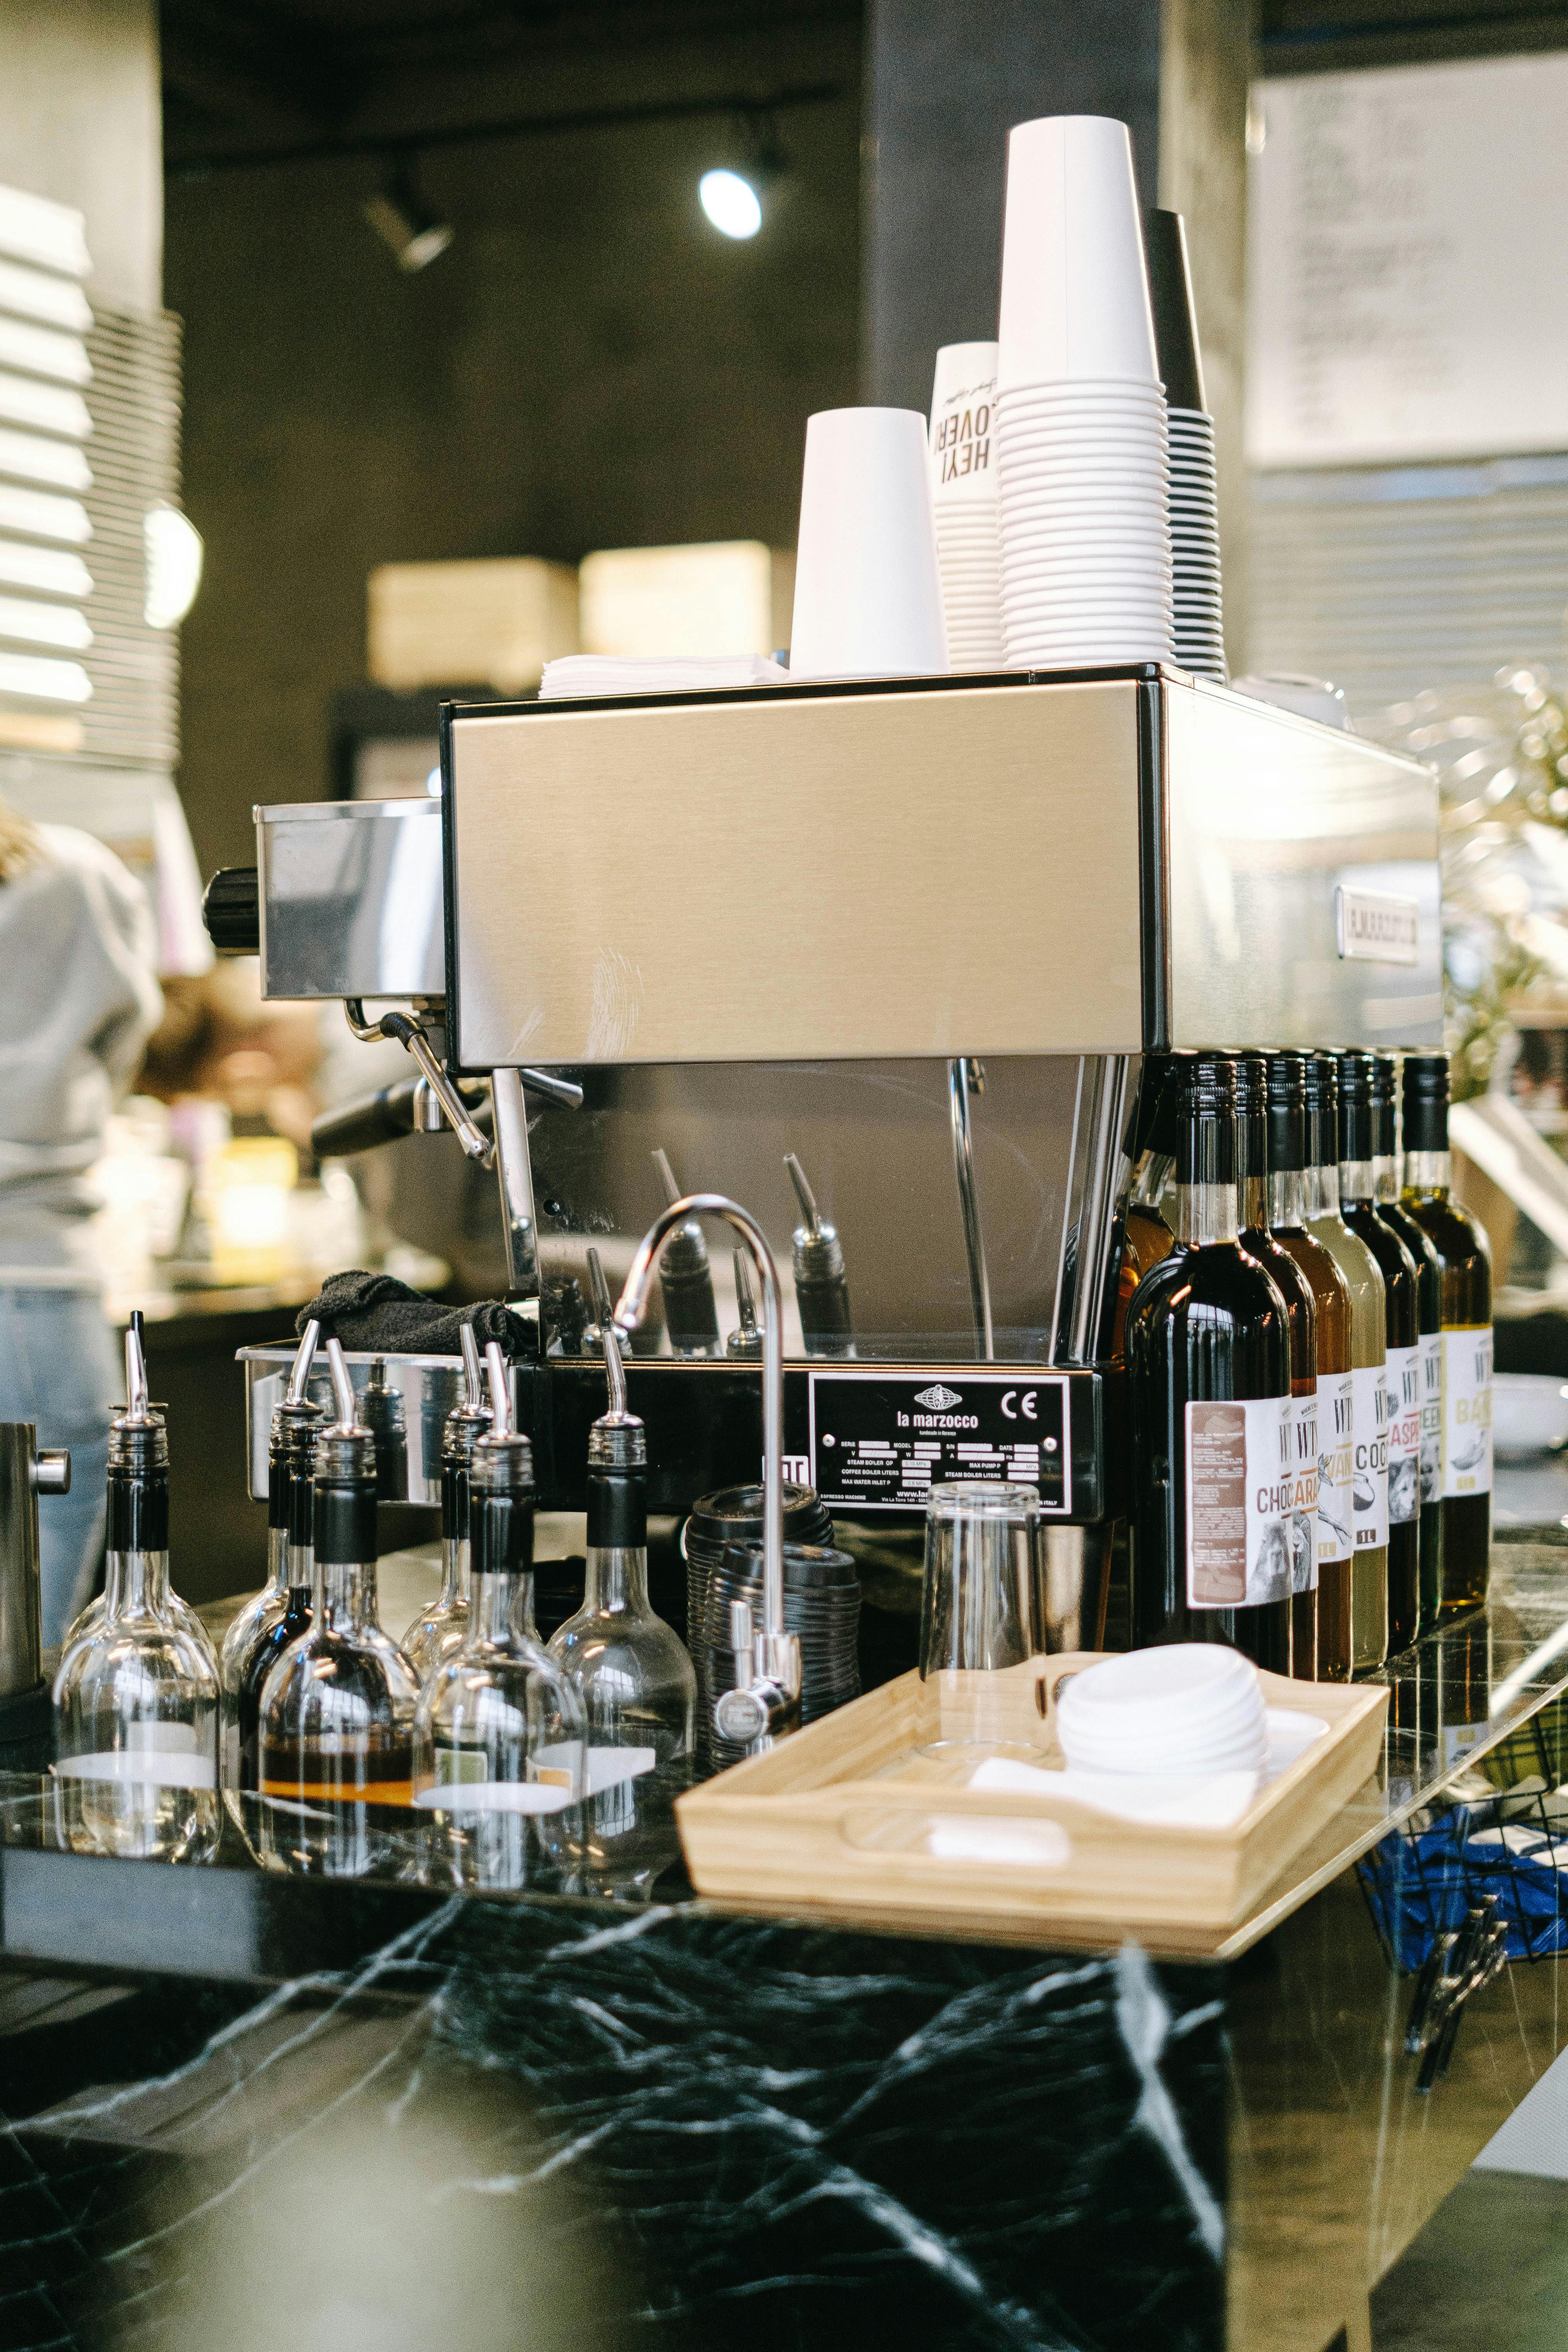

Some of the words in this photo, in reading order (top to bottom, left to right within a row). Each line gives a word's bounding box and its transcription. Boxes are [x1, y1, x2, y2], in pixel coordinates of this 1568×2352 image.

[942, 438, 990, 484] HEY!
[897, 1411, 910, 1427] la
[913, 1414, 979, 1428] marzocco
[1001, 1391, 1038, 1420] CE
